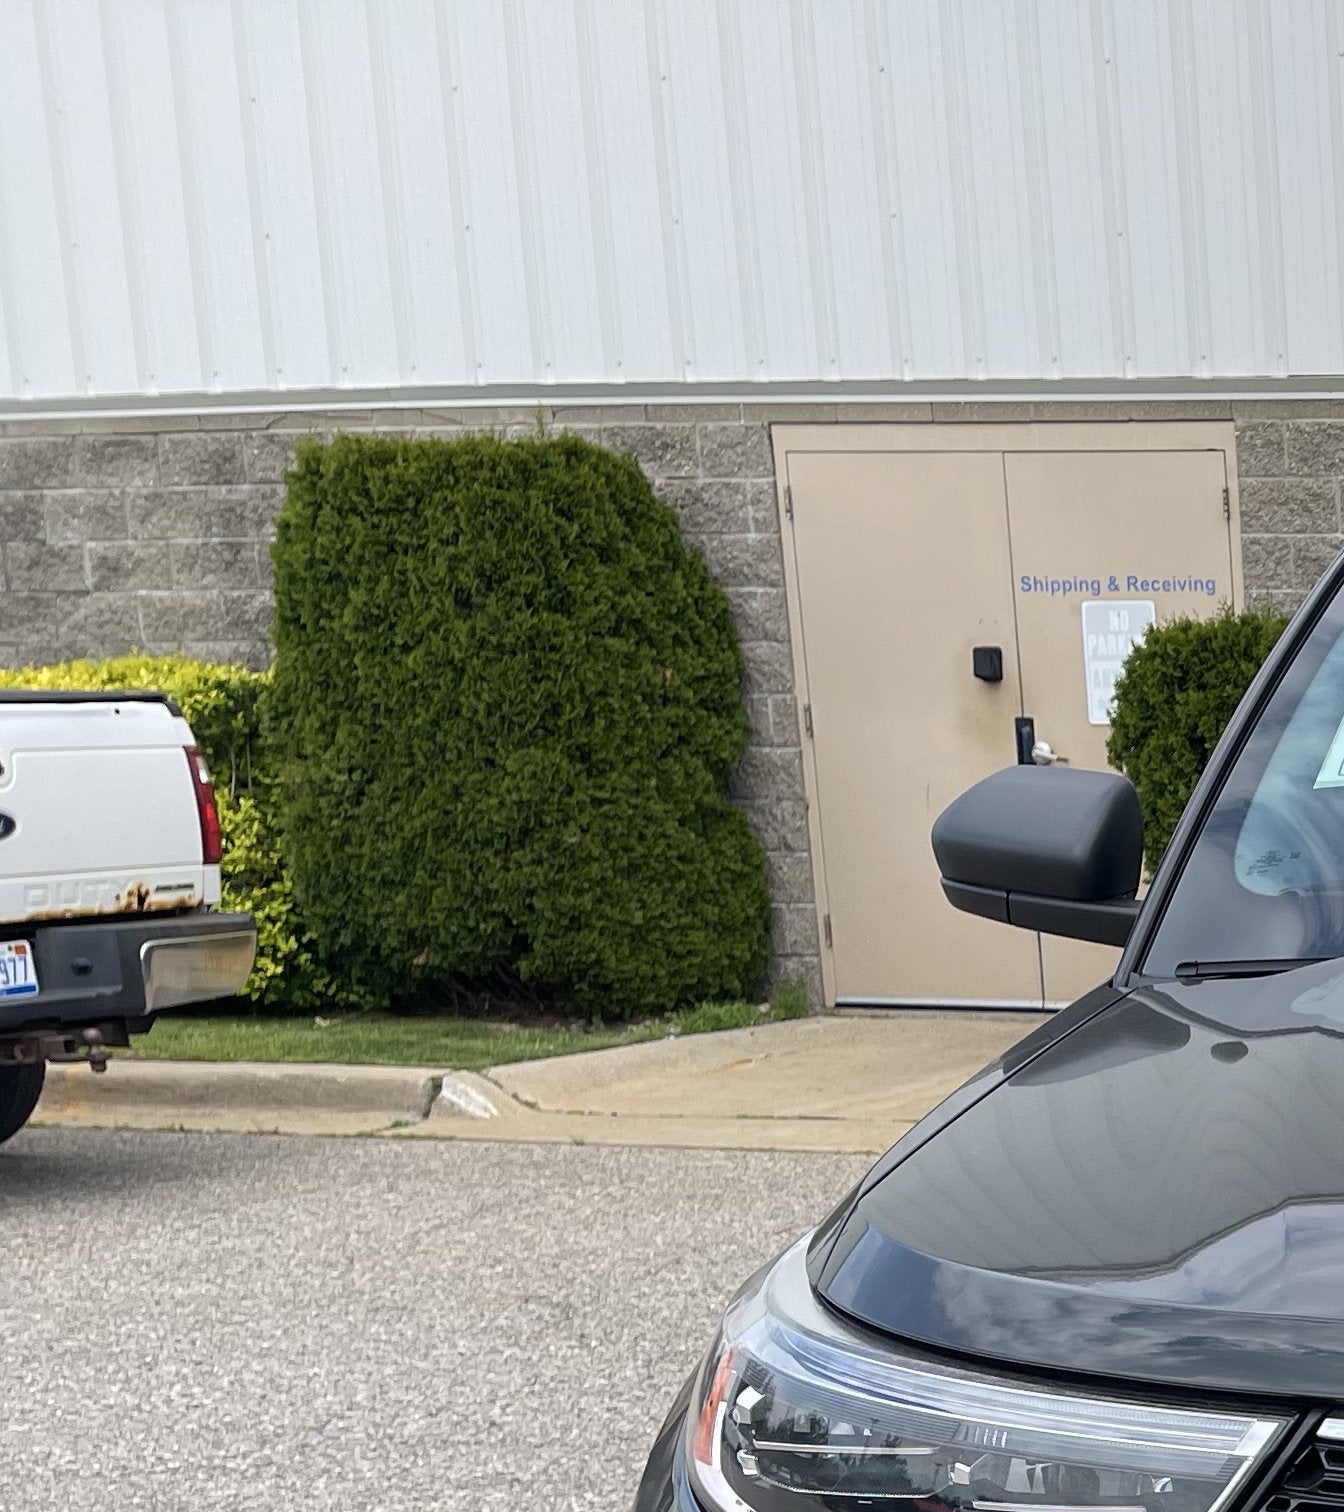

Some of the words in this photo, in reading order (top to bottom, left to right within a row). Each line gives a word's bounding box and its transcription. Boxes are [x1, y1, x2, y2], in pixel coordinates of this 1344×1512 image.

[1020, 575, 1101, 596] Shipping
[1107, 576, 1121, 593] &
[1126, 575, 1217, 596] Receiving
[1108, 610, 1130, 632] NO
[1087, 633, 1140, 656] PARK
[23, 878, 134, 912] DUTY
